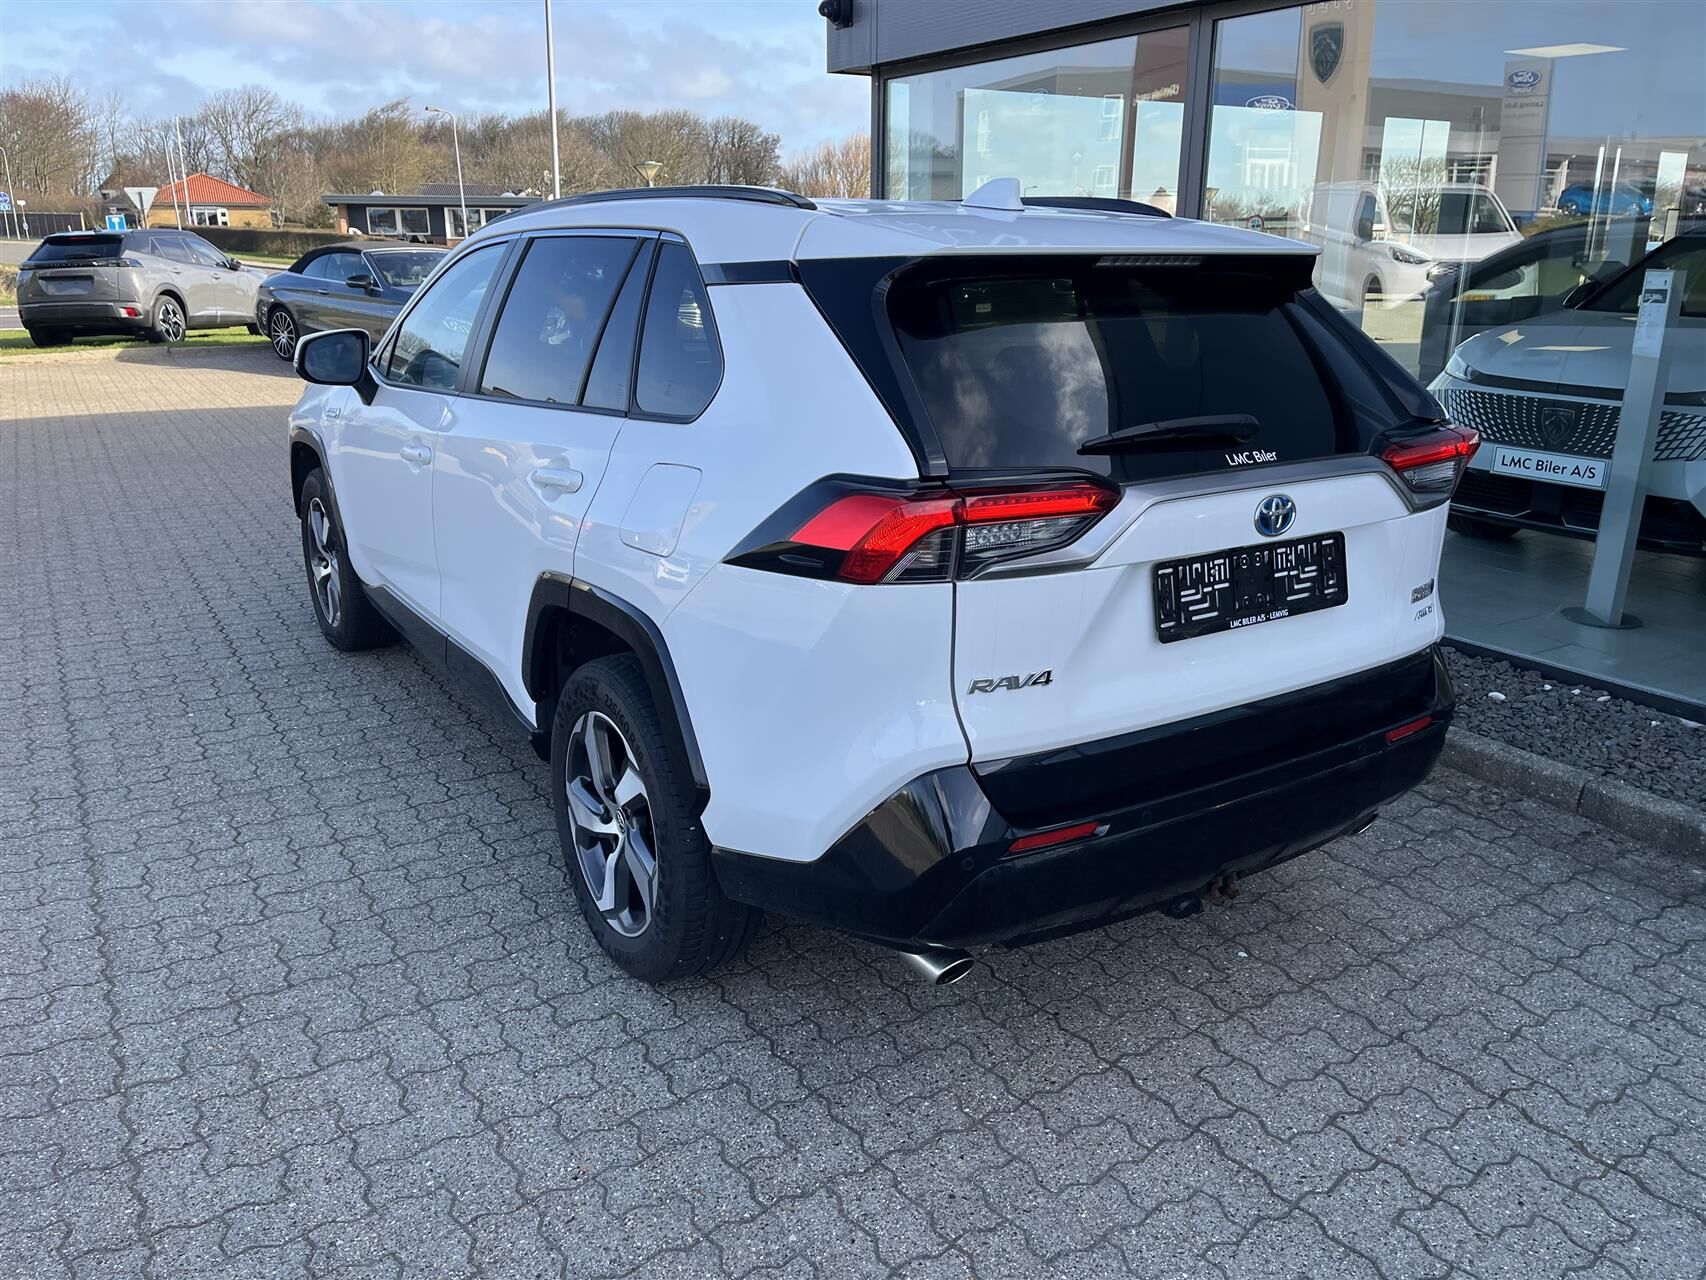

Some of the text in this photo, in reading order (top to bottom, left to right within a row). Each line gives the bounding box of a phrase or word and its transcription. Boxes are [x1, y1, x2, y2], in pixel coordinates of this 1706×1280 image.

[1225, 449, 1277, 466] LMC Biler
[1501, 454, 1596, 479] LMC Biler A/S
[1230, 619, 1242, 628] LMC
[1242, 616, 1257, 626] BILER
[1257, 614, 1266, 623] A/S
[1270, 609, 1289, 619] LEMVIG
[967, 667, 1053, 694] RAV4
